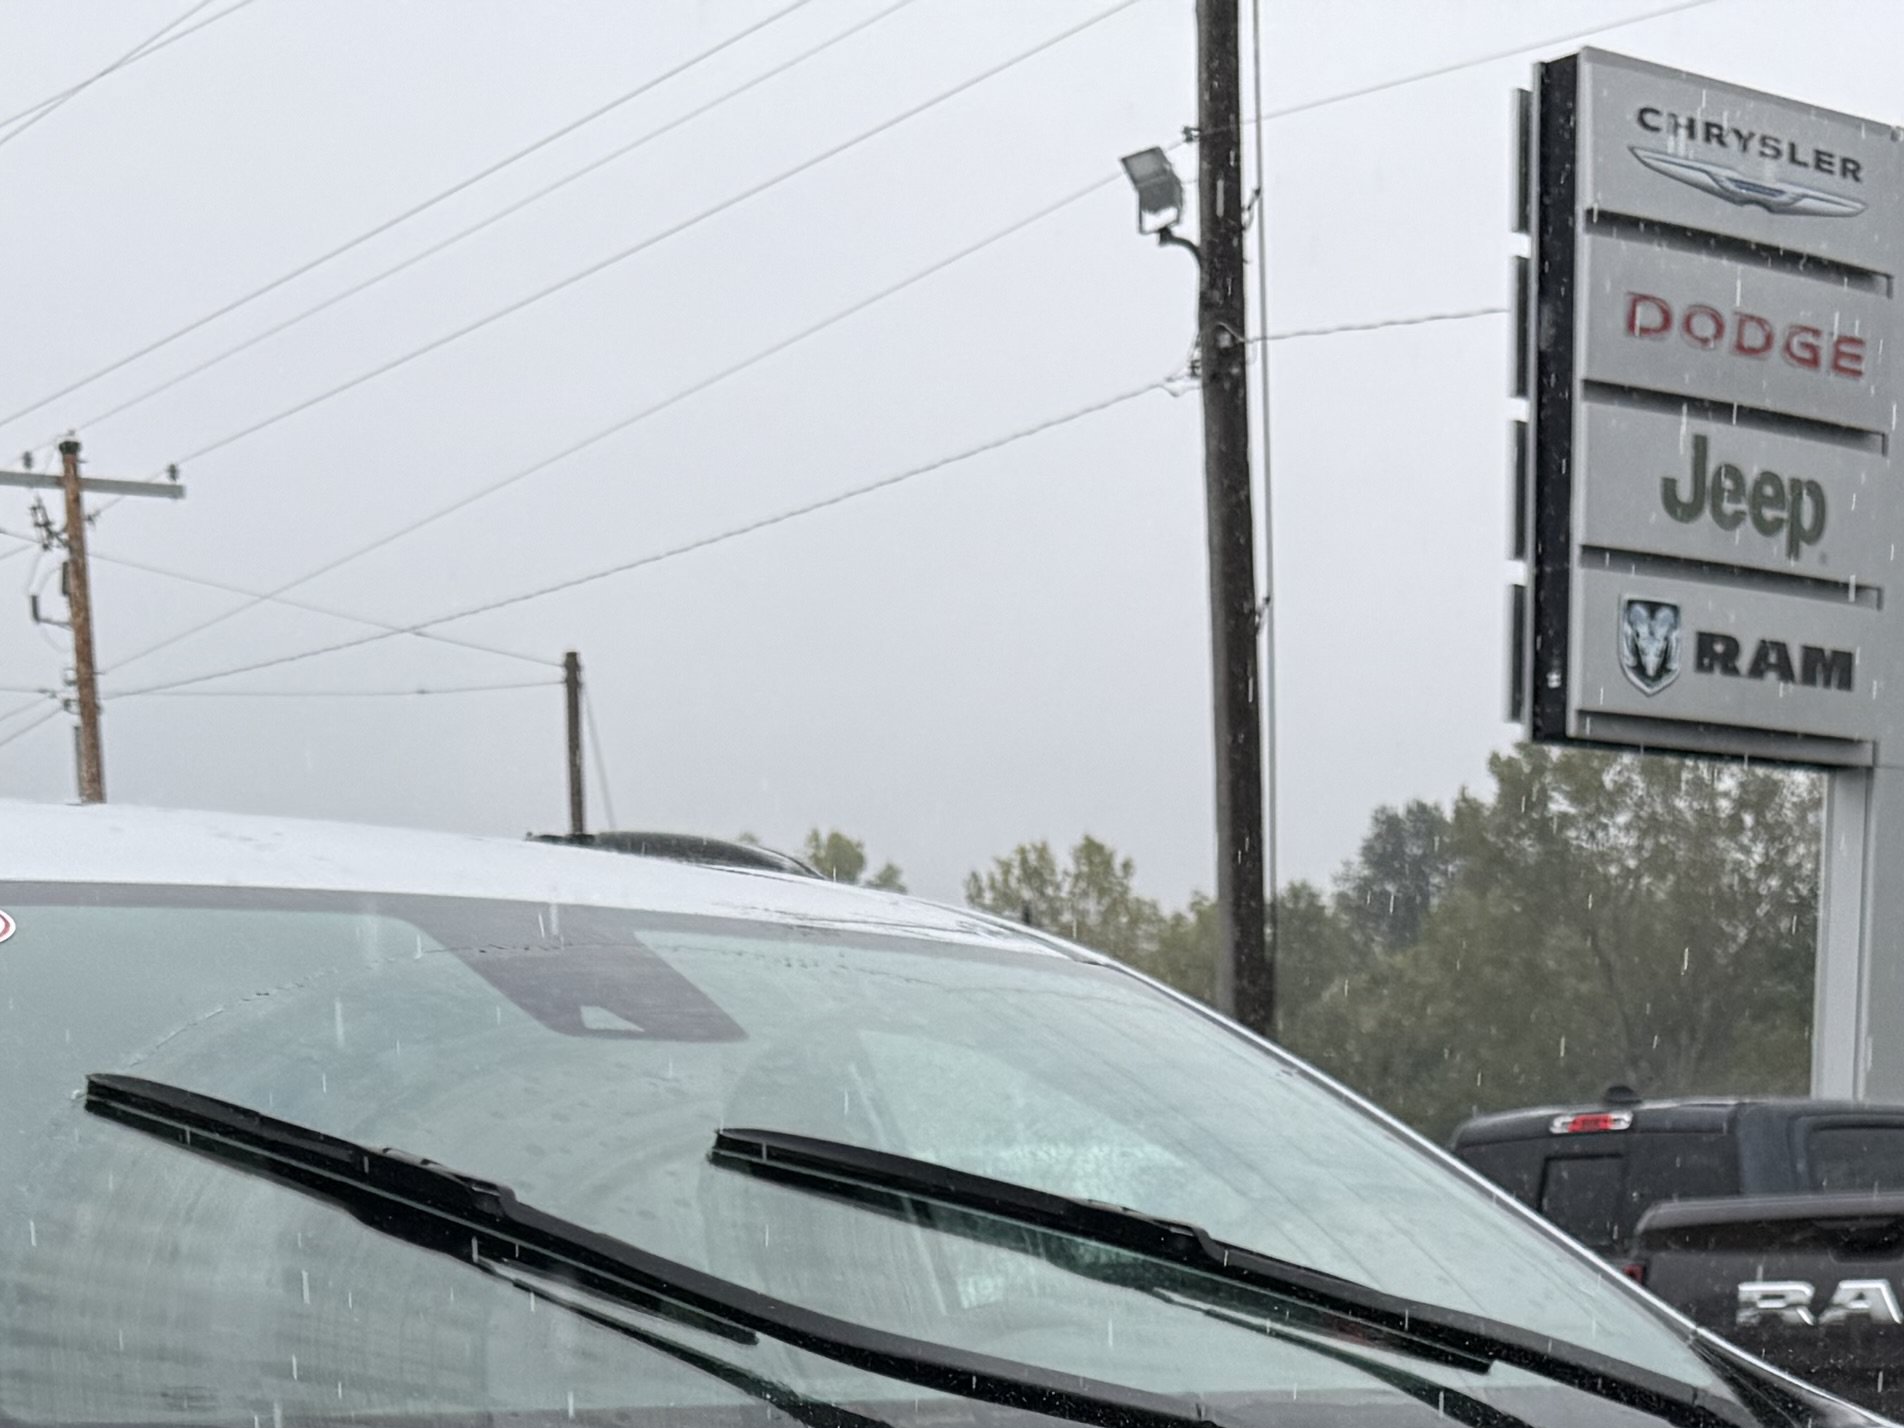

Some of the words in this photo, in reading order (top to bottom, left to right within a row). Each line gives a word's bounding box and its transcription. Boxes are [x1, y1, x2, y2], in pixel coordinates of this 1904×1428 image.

[1637, 107, 1863, 183] CHRYSLER
[1626, 292, 1867, 378] DODGE
[1661, 435, 1826, 560] Jeep
[1695, 631, 1854, 691] RAM
